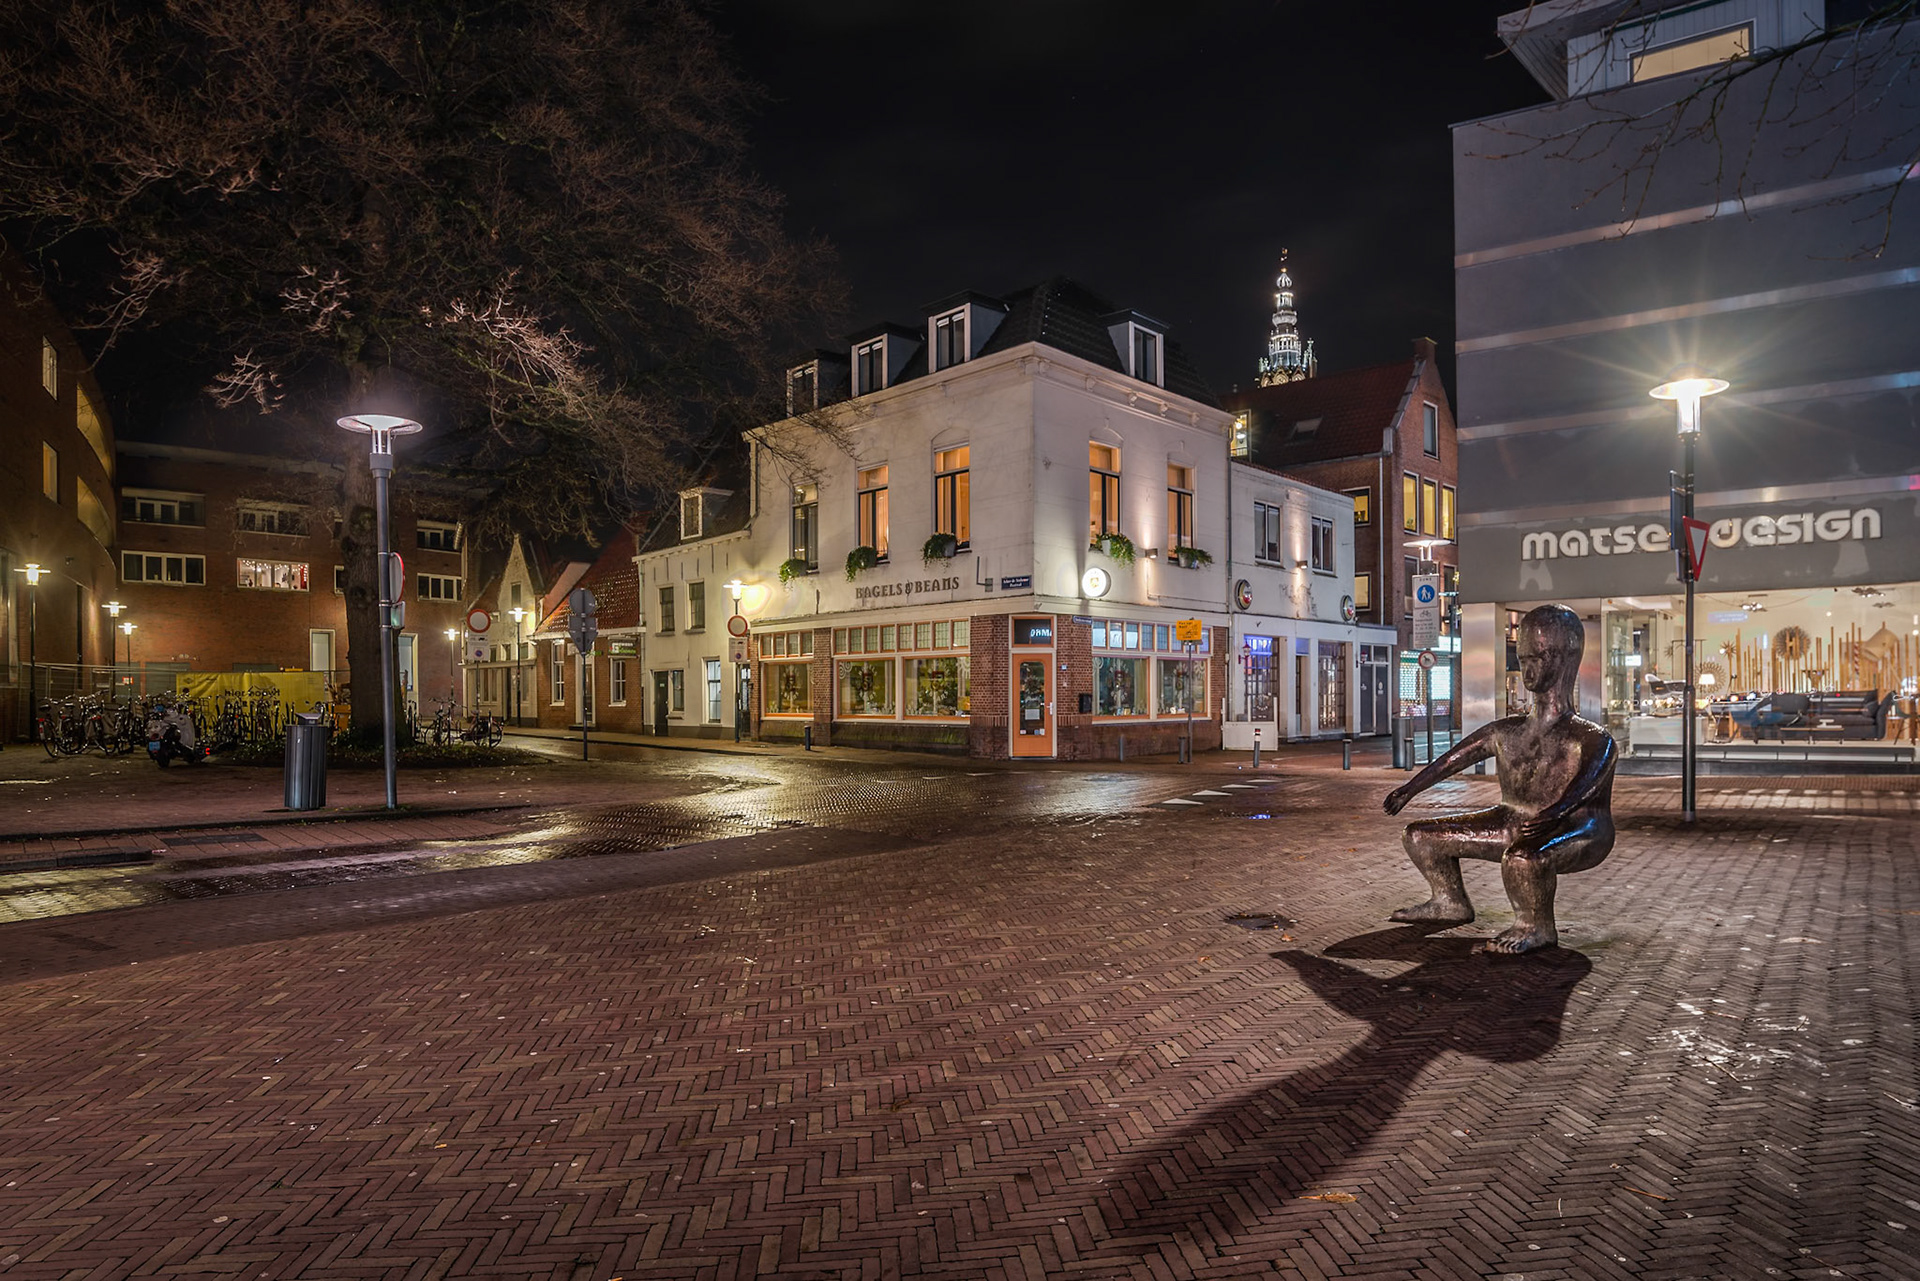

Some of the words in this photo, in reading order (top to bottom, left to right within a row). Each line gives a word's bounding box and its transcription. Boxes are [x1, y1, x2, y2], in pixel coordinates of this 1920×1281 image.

[1522, 524, 1673, 561] matse
[1710, 508, 1882, 549] design
[855, 582, 903, 599] BAGELS
[914, 576, 959, 594] BEANS
